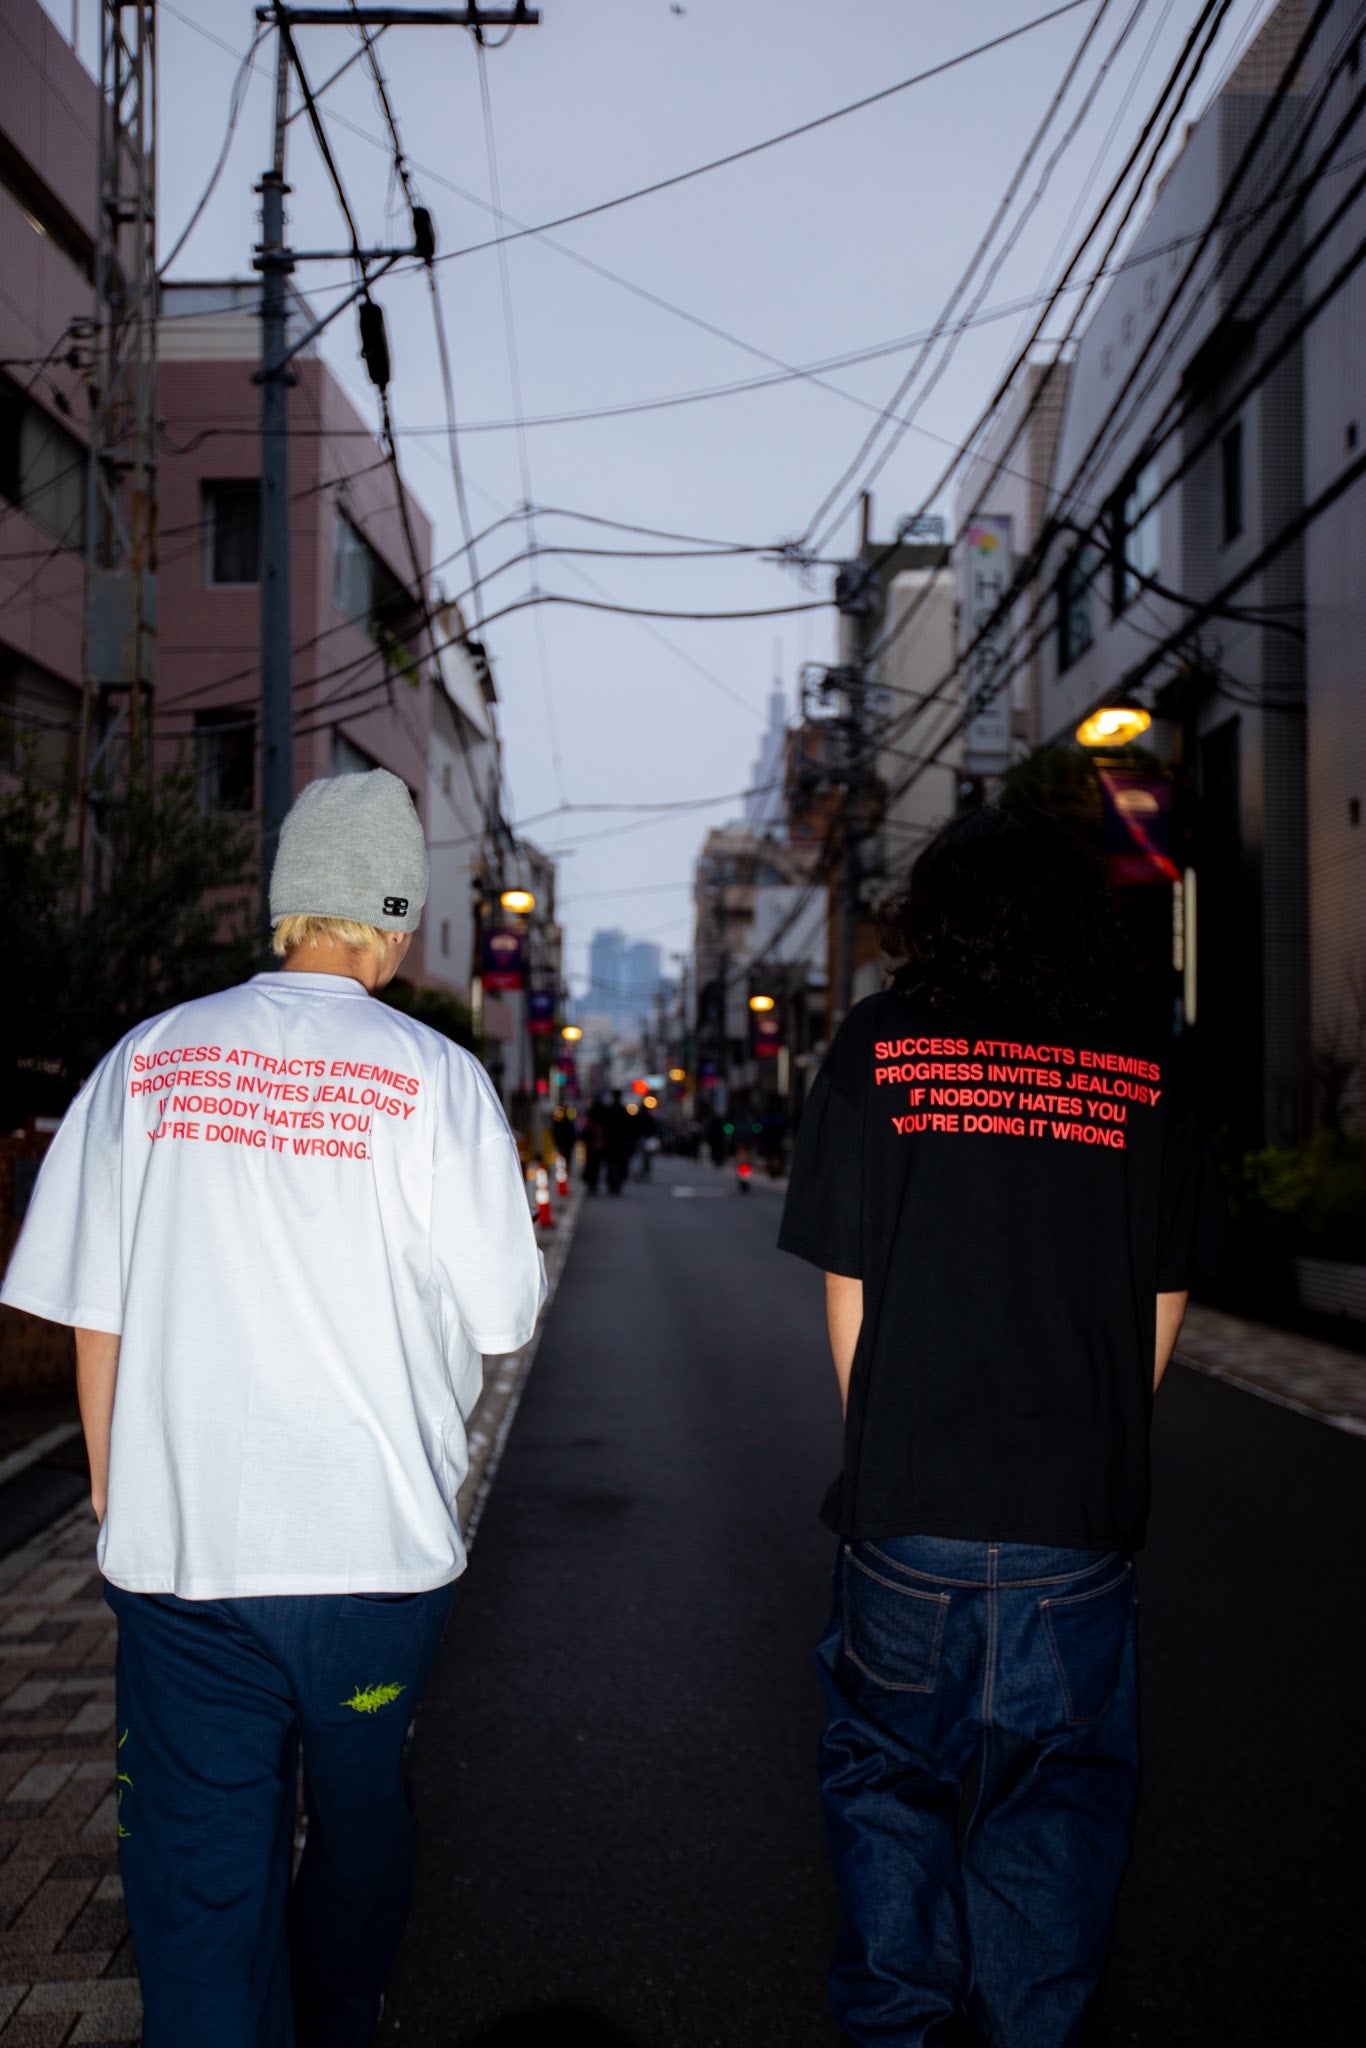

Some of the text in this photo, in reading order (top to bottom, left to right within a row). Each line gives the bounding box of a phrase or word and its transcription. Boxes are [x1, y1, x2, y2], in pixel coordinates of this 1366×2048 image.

[133, 1046, 419, 1096] SUCCESS ATTRACTS ENEMIES
[875, 1037, 1160, 1081] SUCCESS ATTRACTS ENEMIES
[130, 1070, 415, 1120] PROGRESS INVITES JEALOUSY
[875, 1062, 1161, 1106] PROGRESS INVITES JEALOUSY
[910, 1088, 925, 1106] IF
[930, 1088, 1015, 1108] NOBODY
[1019, 1094, 1082, 1115] HATES
[172, 1094, 259, 1119] NOBODY
[263, 1108, 324, 1129] HATES
[330, 1111, 372, 1136] YOU,
[892, 1113, 959, 1133] YOU'RE
[963, 1114, 1025, 1135] DOING
[1029, 1119, 1048, 1137] IT
[205, 1124, 266, 1148] DOING
[271, 1135, 288, 1152] IT
[292, 1138, 371, 1160] WRONG.
